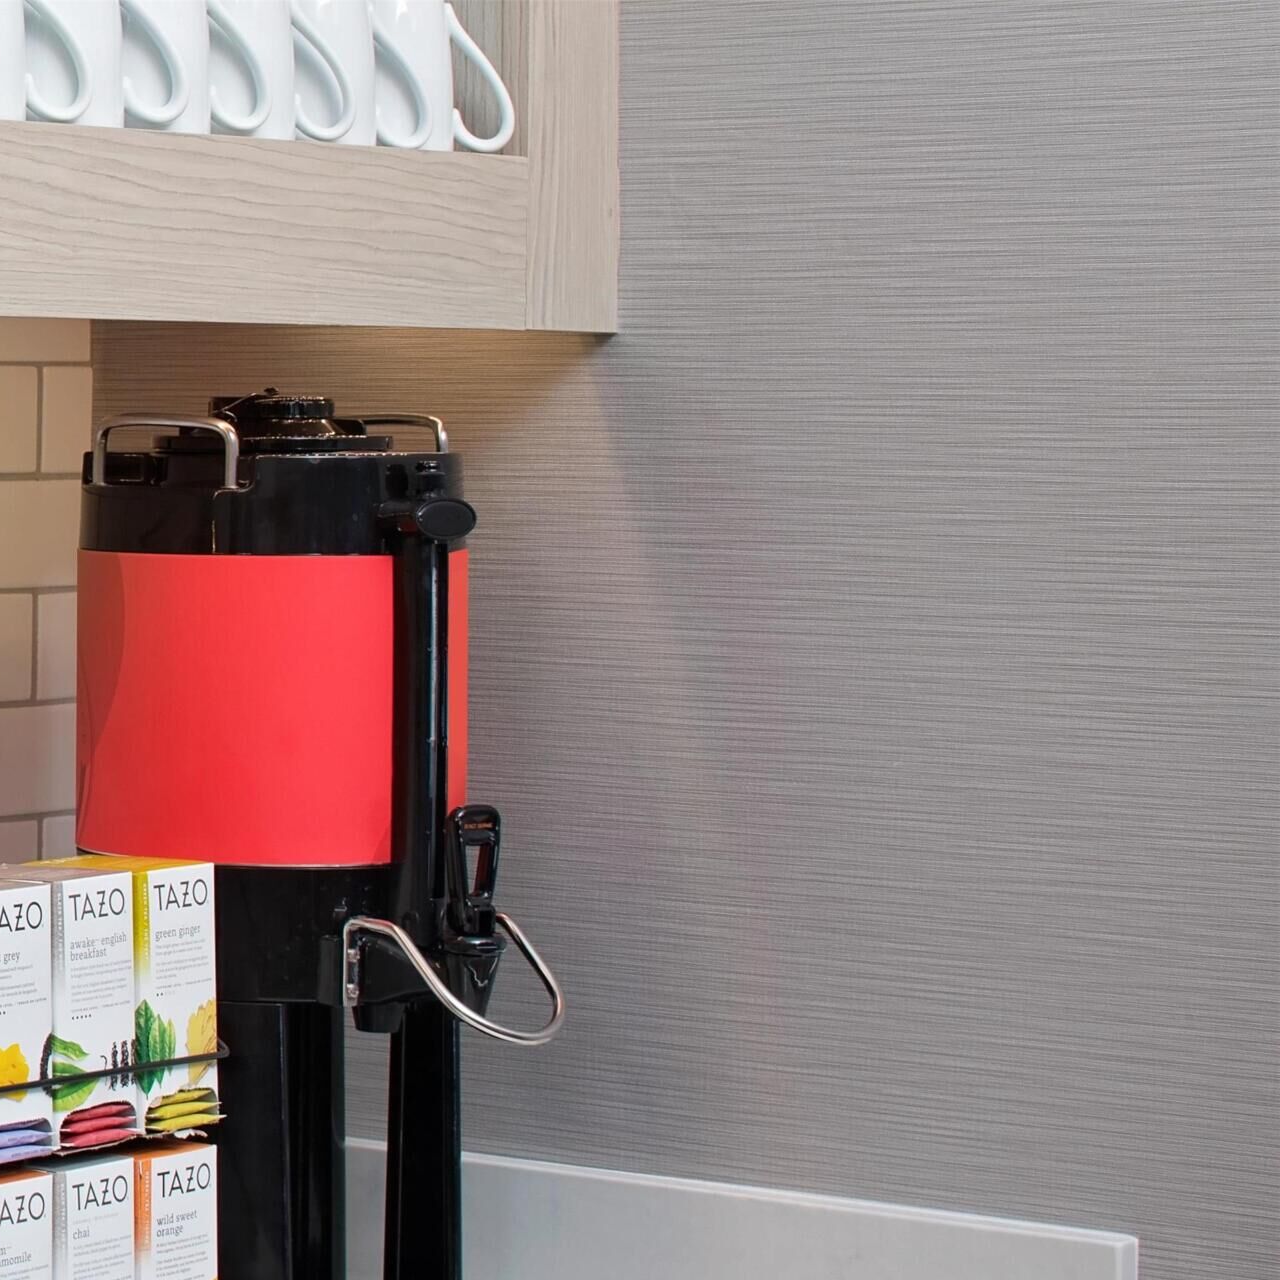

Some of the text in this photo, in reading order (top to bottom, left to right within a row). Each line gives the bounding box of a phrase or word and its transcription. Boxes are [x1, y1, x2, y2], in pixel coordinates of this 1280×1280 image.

[153, 879, 208, 911] TAZO
[68, 888, 125, 921] TAZO
[101, 932, 127, 947] english
[155, 925, 201, 942] green ginger
[3, 951, 21, 965] grey
[70, 947, 107, 961] breakfast
[157, 1163, 211, 1198] TAZO
[72, 1175, 128, 1211] TAZO
[156, 1209, 198, 1226] wild sweet
[72, 1226, 90, 1240] chai
[156, 1224, 184, 1238] orange
